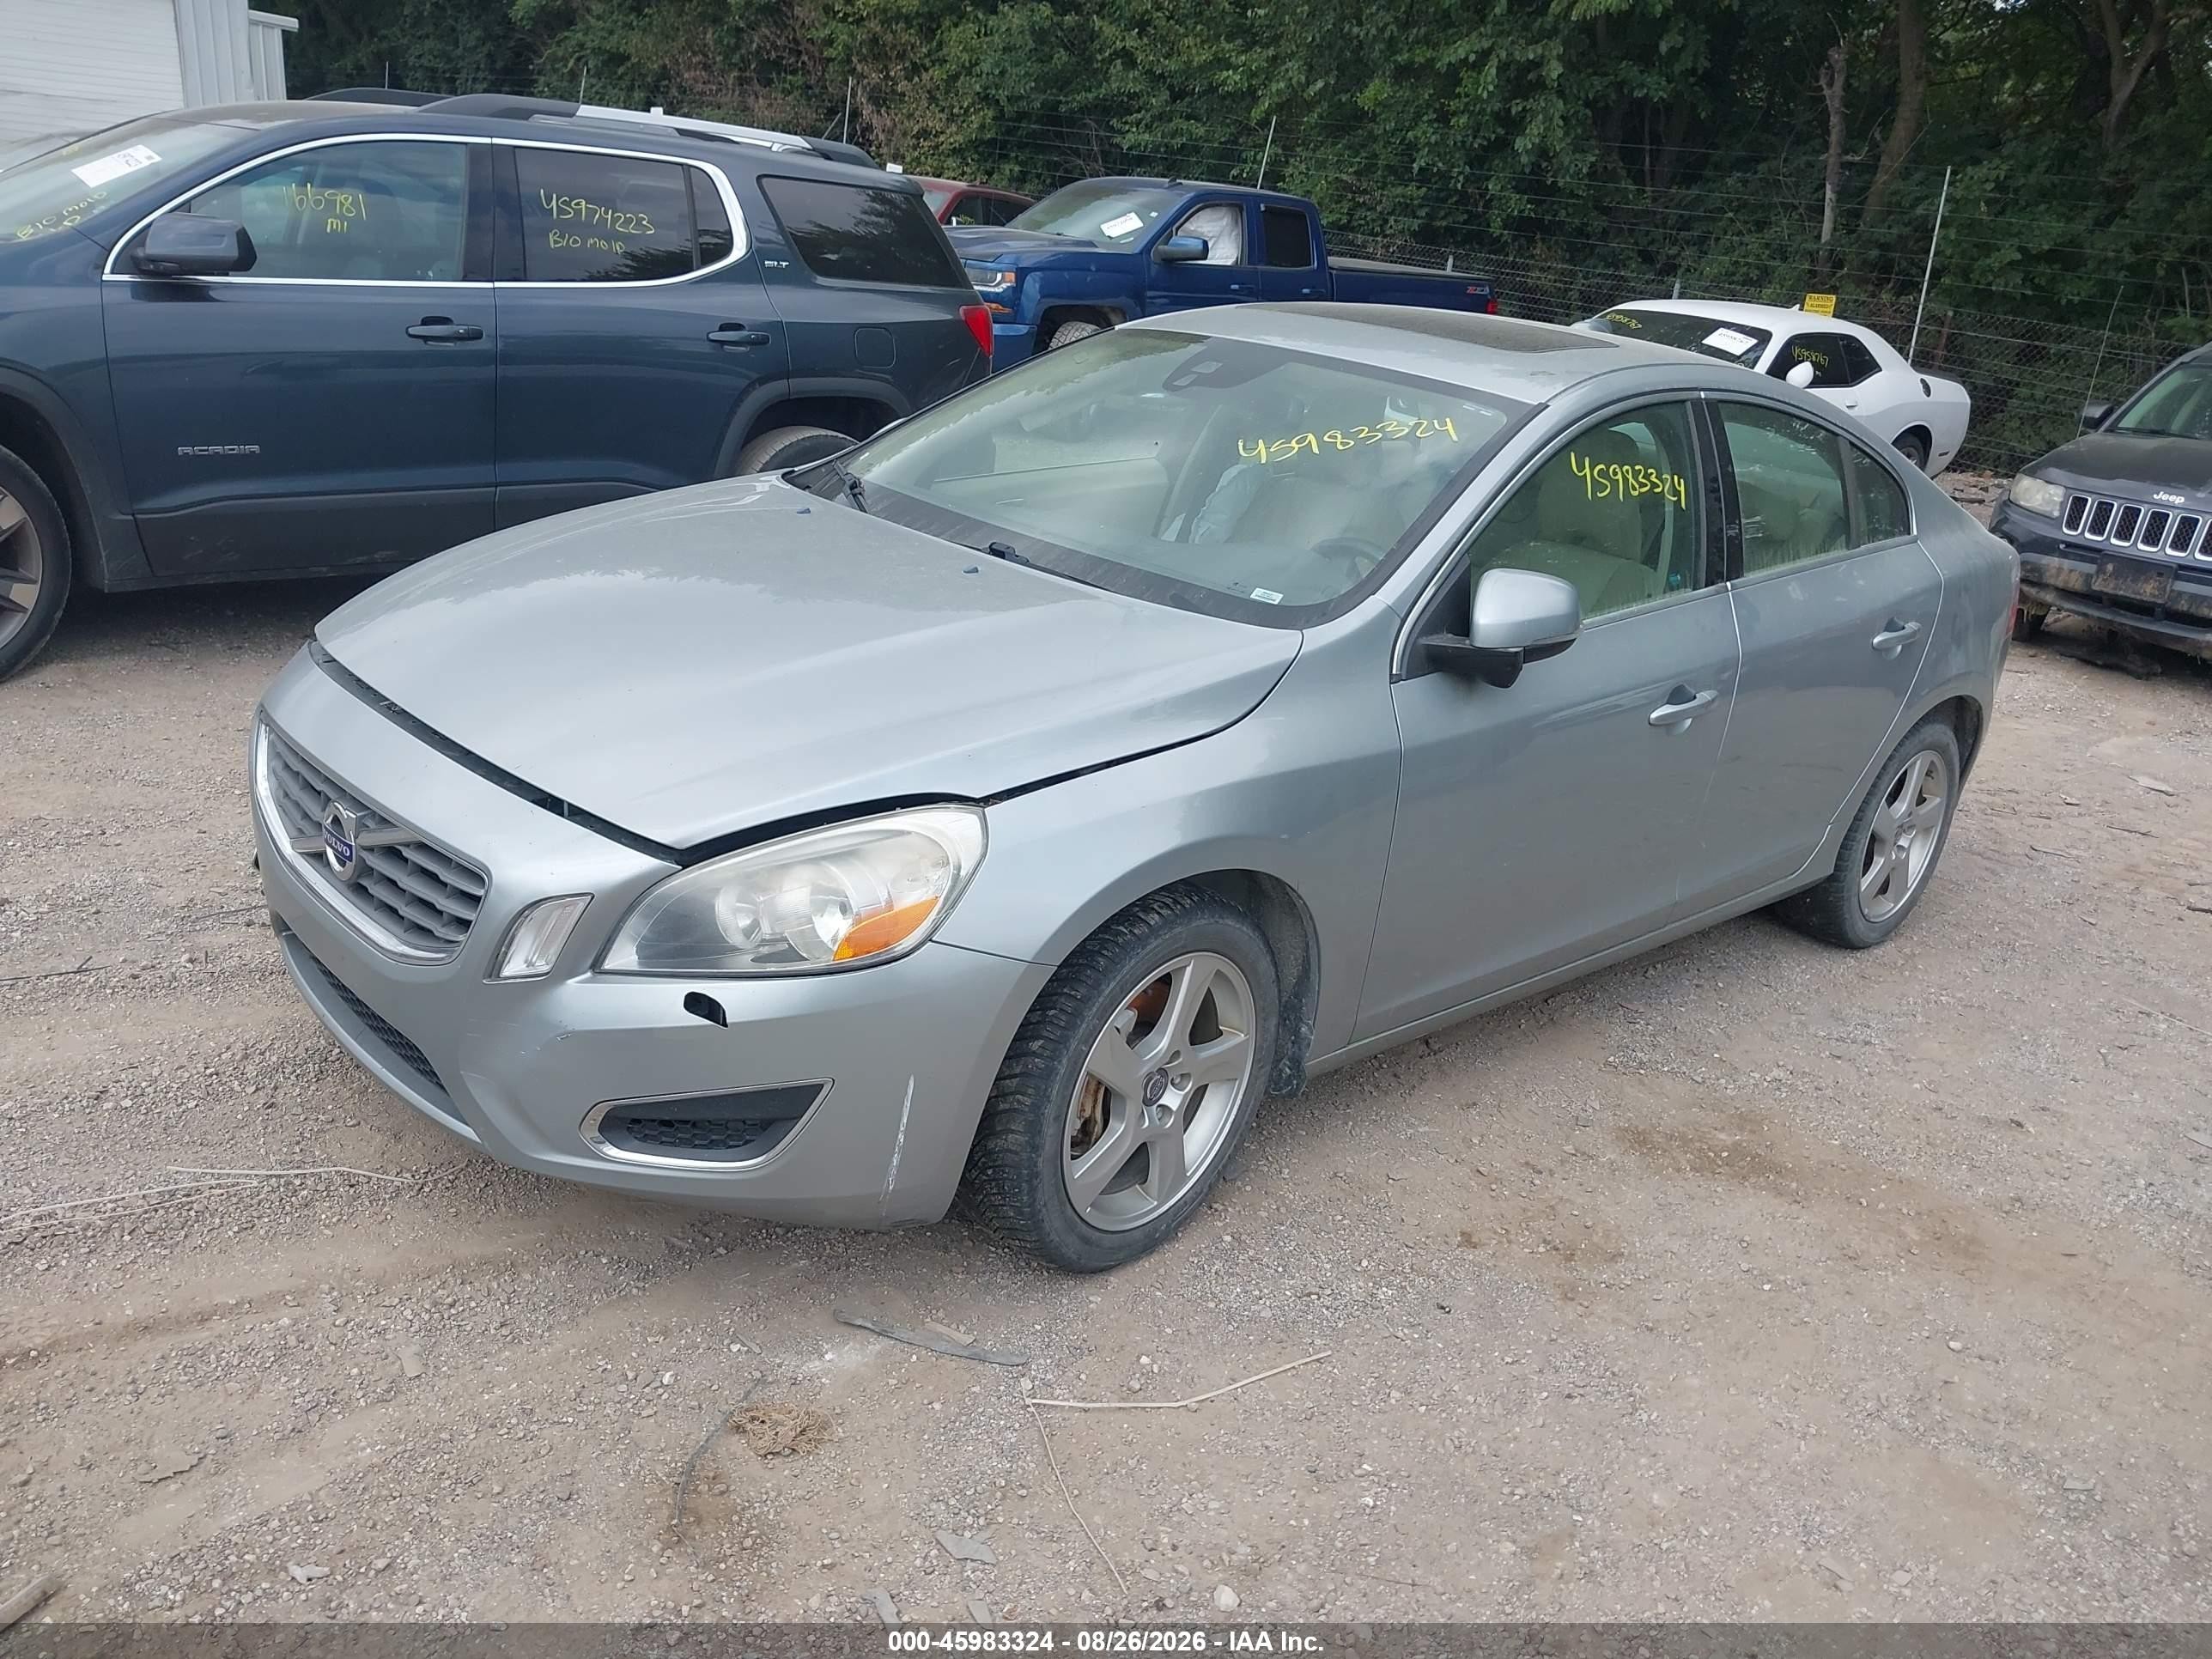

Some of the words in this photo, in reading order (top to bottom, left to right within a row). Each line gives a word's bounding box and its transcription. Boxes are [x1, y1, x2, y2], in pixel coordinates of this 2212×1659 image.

[282, 182, 367, 221] 166981
[540, 188, 655, 234] 45974223
[1791, 344, 1829, 368] 45958767
[177, 445, 261, 456] ACADIA
[1237, 417, 1459, 465] 45983324
[1570, 451, 1686, 511] 45983324
[2153, 490, 2185, 504] Jeep
[323, 827, 350, 856] VOLVO
